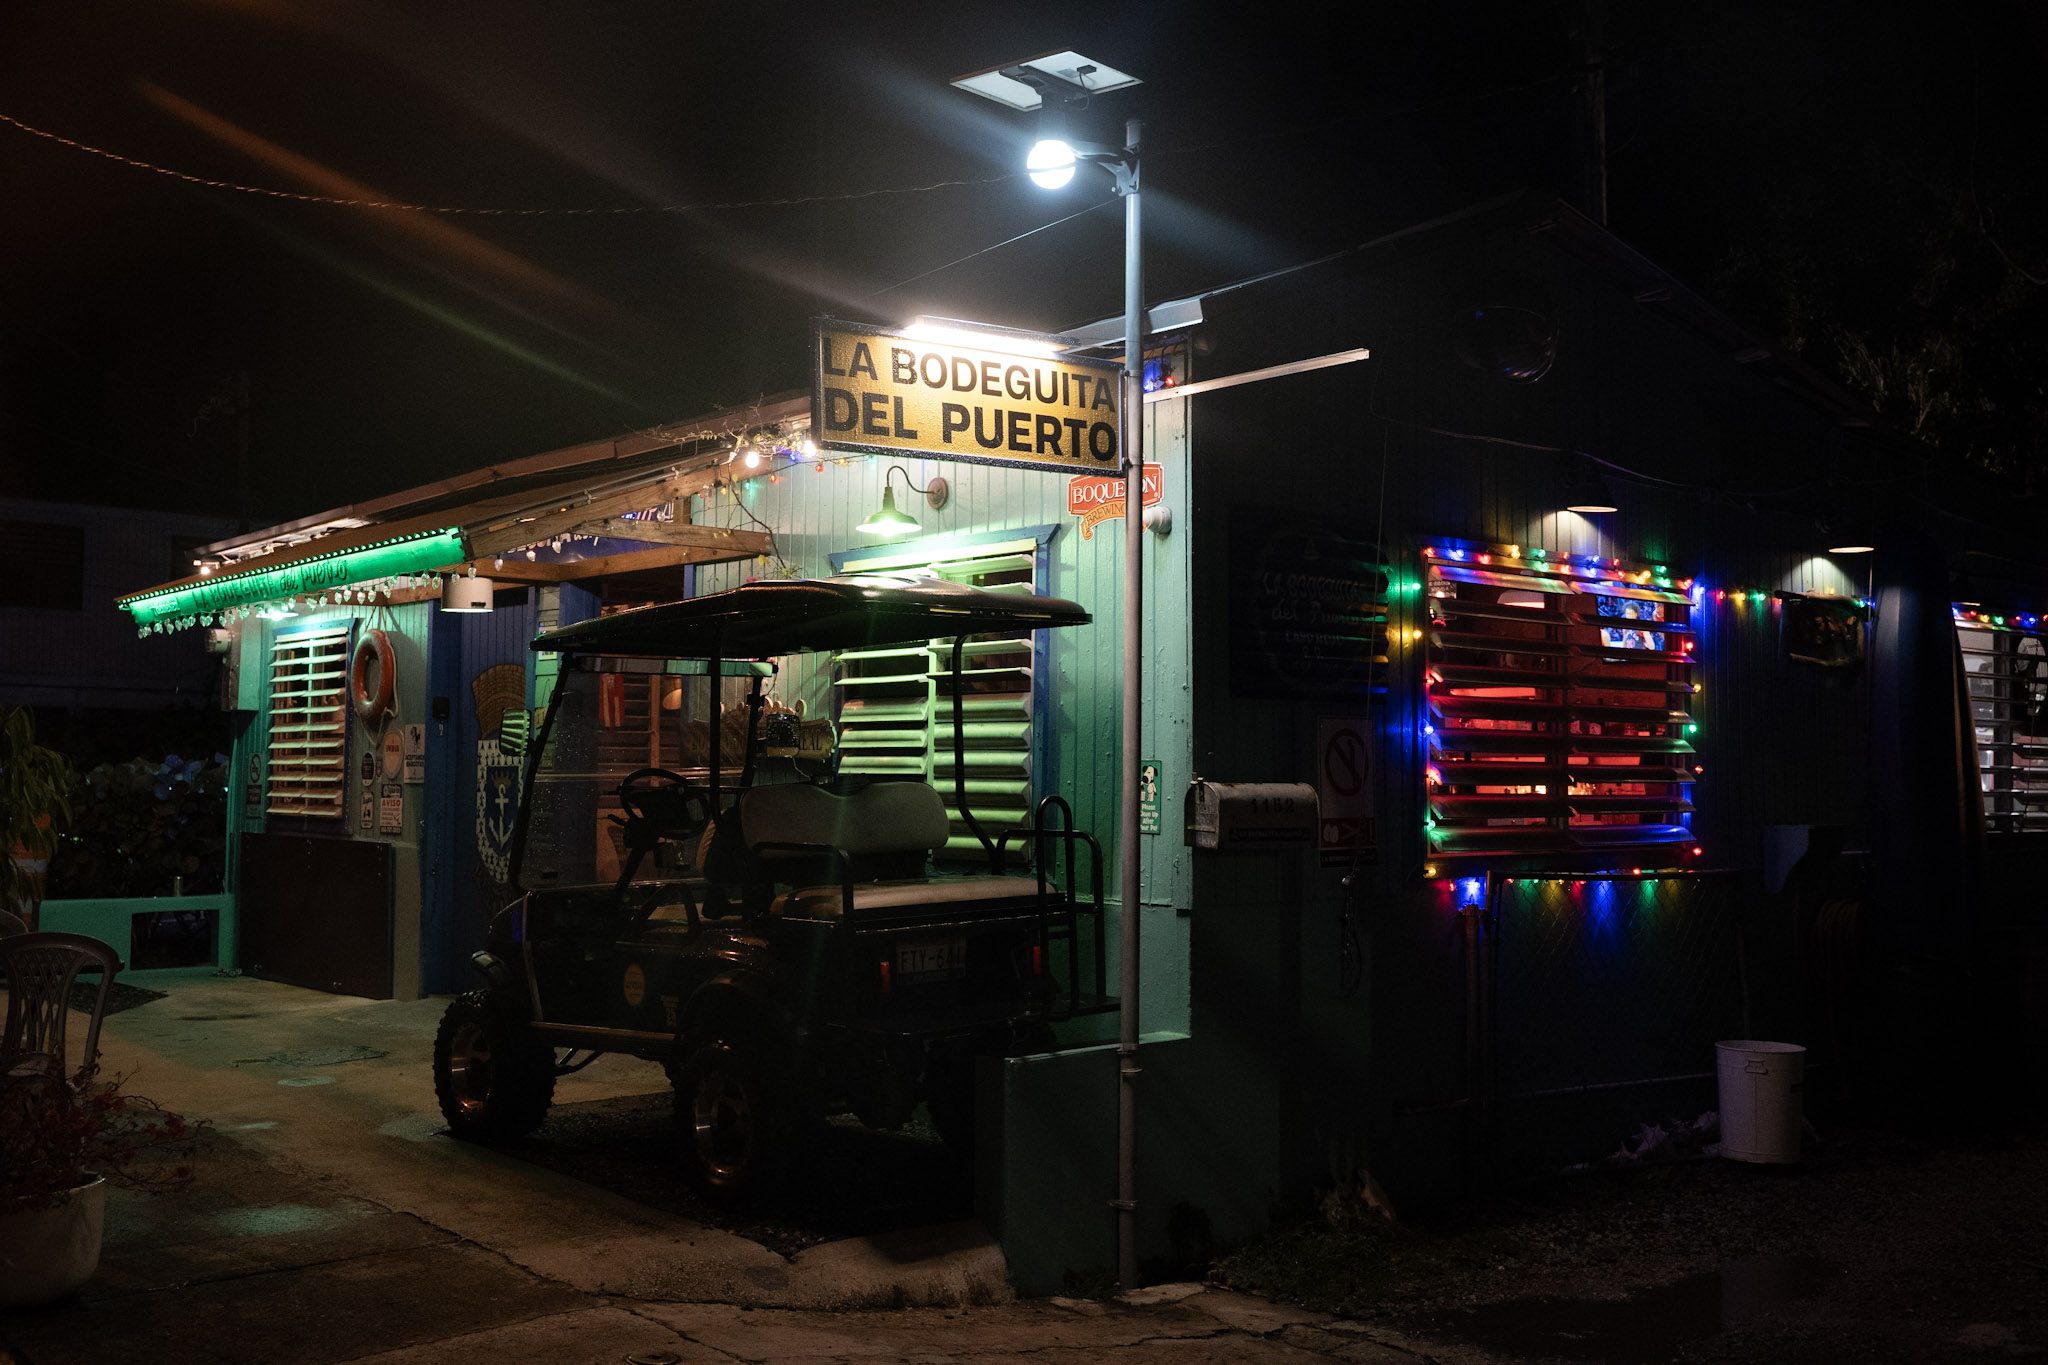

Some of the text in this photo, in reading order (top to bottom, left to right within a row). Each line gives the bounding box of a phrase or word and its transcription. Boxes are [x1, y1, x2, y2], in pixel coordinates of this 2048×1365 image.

[823, 337, 1116, 413] LA BODEGUITA
[823, 387, 1118, 462] DEL PUERTO
[1072, 474, 1158, 504] BOQUEN
[382, 799, 401, 807] AVISO
[1252, 798, 1294, 814] 1152
